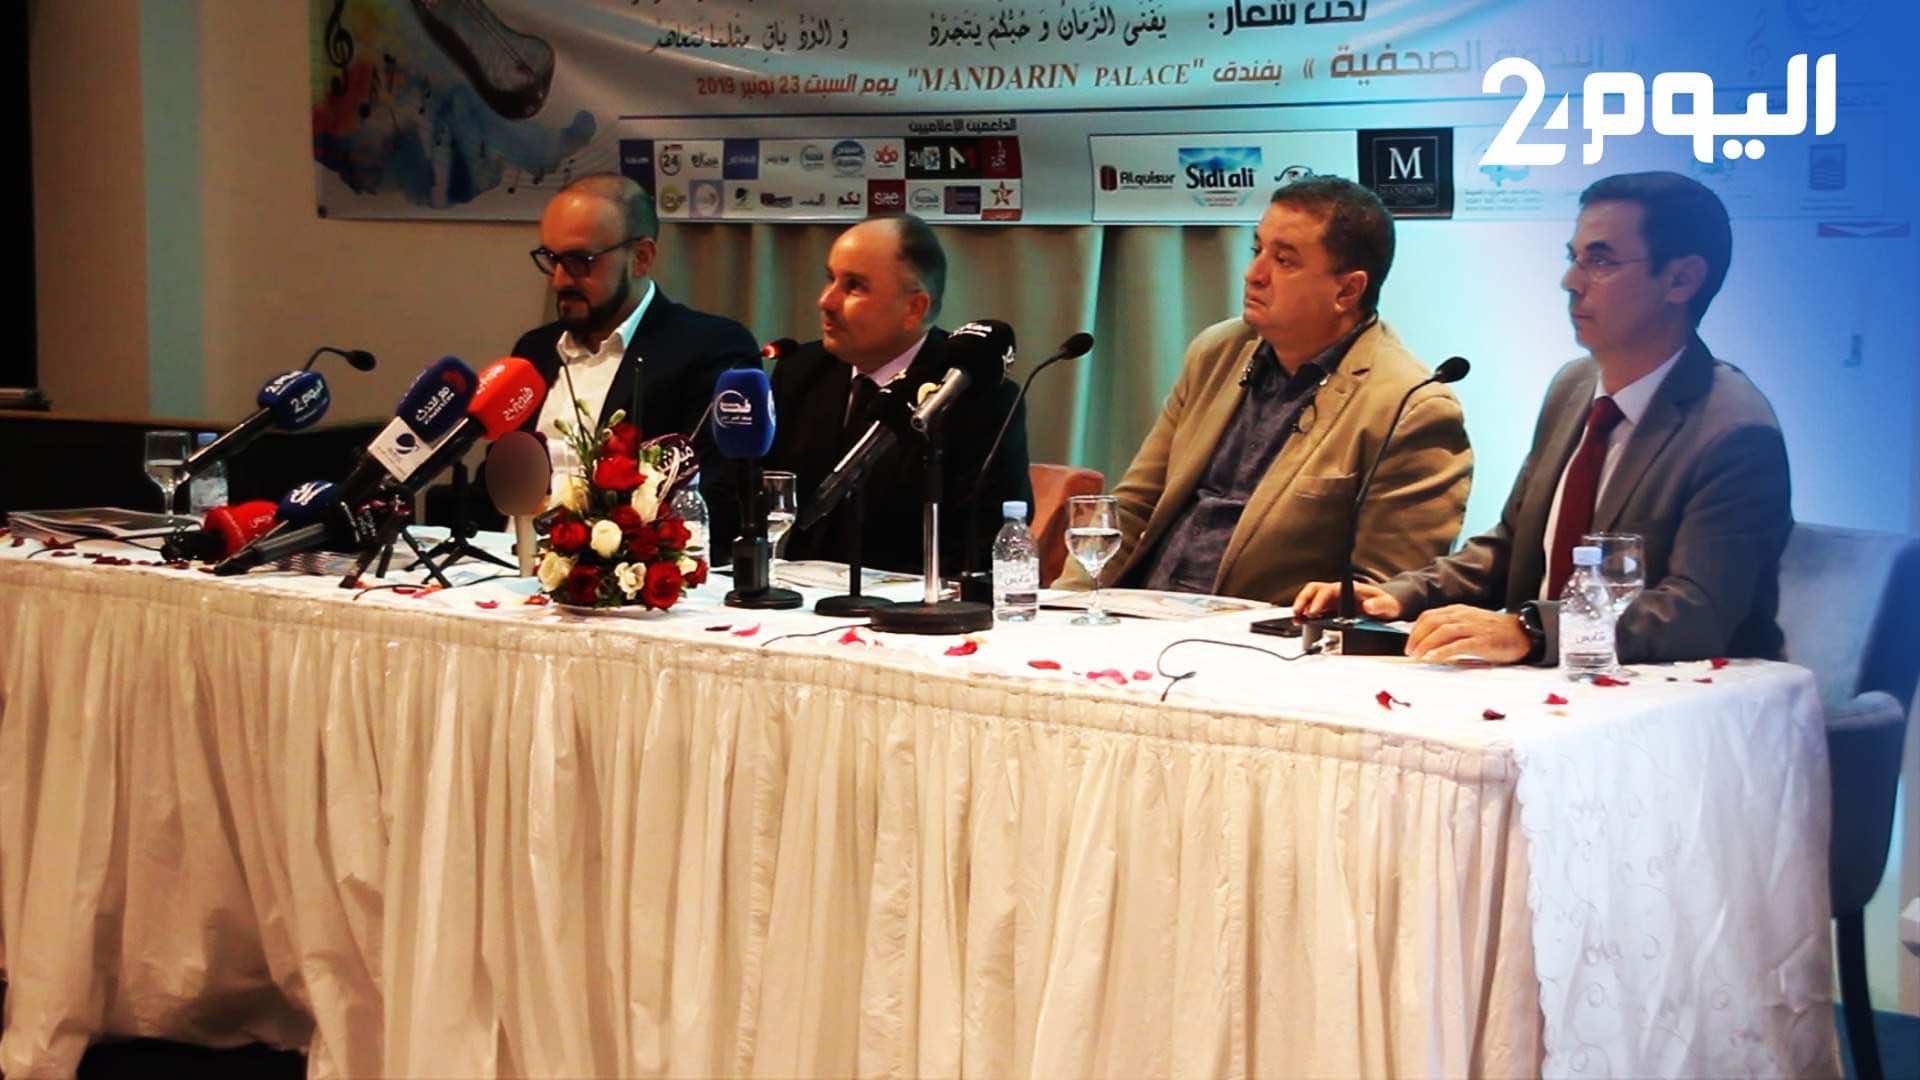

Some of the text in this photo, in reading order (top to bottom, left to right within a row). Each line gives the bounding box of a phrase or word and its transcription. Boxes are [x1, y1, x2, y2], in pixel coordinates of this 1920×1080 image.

[779, 75, 800, 95] 23
[1212, 59, 1283, 86] بفندق
[804, 73, 857, 98] السبت
[859, 76, 899, 97] يوم
[1388, 146, 1423, 180] M
[1186, 164, 1226, 189] Sidi
